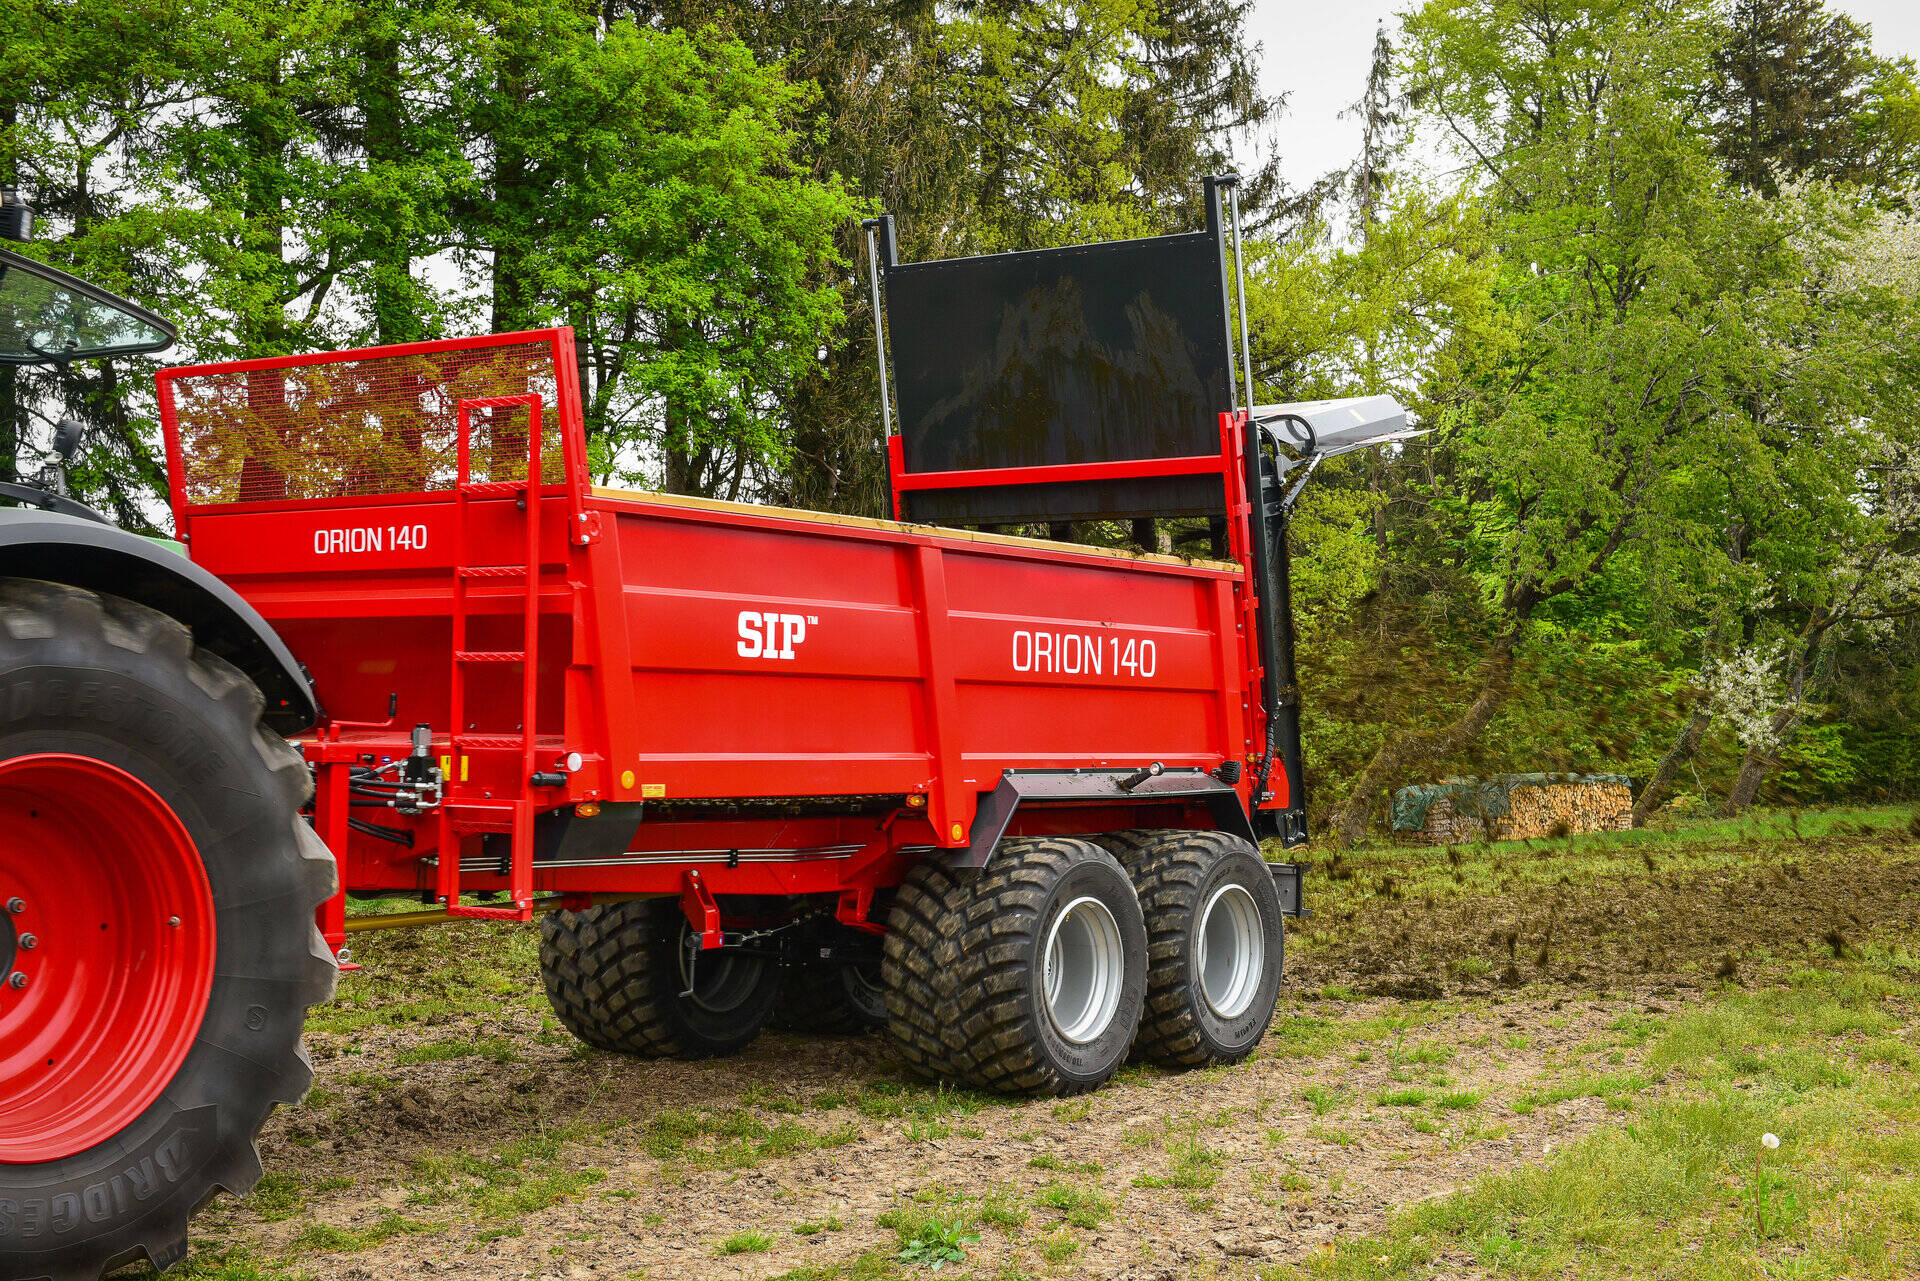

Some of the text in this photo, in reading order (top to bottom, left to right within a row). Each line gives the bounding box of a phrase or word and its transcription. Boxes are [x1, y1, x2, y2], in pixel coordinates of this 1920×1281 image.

[314, 524, 428, 554] ORION 140
[737, 610, 806, 660] SIP
[1012, 630, 1156, 678] ORION 140
